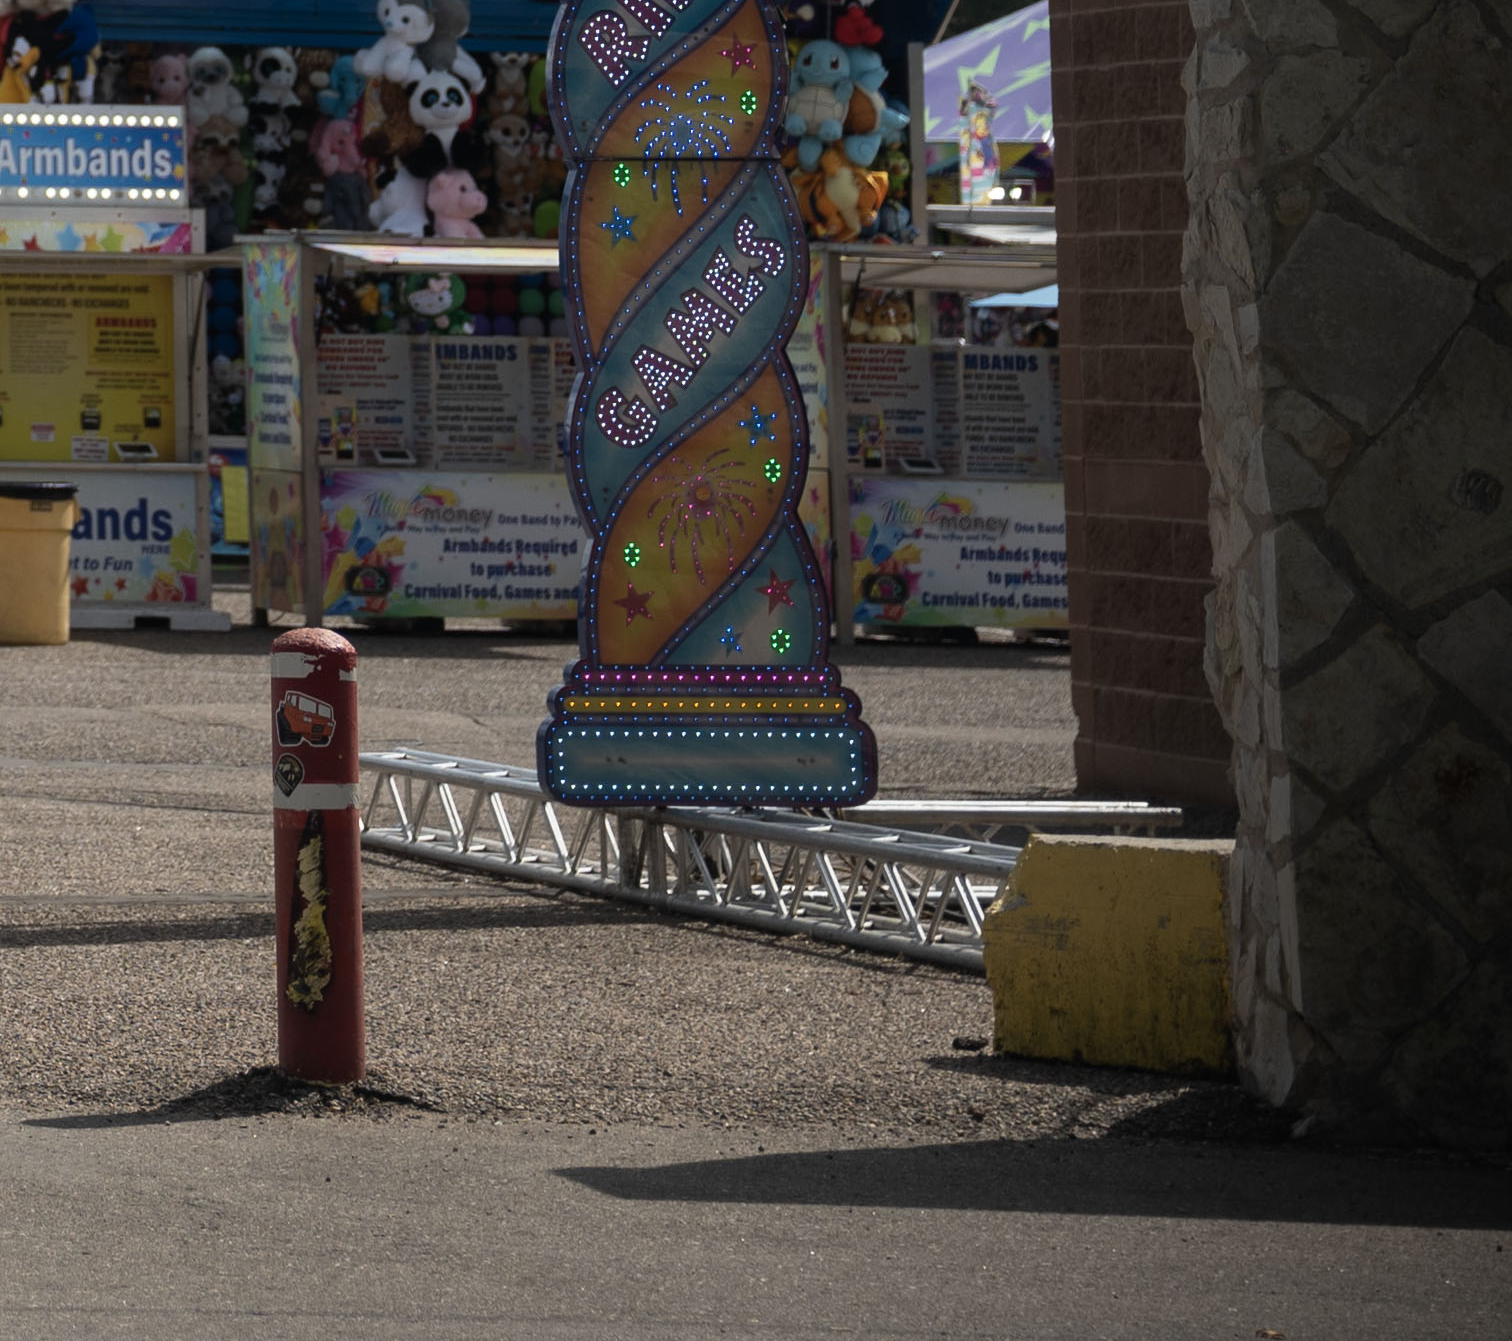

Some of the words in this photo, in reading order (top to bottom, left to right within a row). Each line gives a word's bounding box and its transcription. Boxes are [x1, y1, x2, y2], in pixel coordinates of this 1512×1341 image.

[597, 213, 786, 449] GAMES
[435, 343, 519, 362] MBANDS
[963, 353, 1039, 373] MBANDS
[69, 497, 174, 543] ands
[422, 506, 494, 527] money
[498, 513, 518, 525] One
[520, 513, 548, 525] Band
[939, 515, 1009, 536] money
[1014, 522, 1035, 534] One
[443, 538, 513, 554] Armbands
[515, 538, 578, 557] Required
[960, 546, 1030, 563] Armbands
[1032, 547, 1067, 565] Requ
[83, 556, 100, 571] to
[103, 556, 134, 571] Fun
[470, 561, 485, 576] to
[487, 561, 553, 579] purchase
[987, 570, 1002, 585] to
[404, 583, 462, 600] Carnival
[465, 584, 502, 601] Food,
[505, 585, 551, 600] Games
[553, 584, 580, 600] and
[921, 591, 980, 608] Carnival
[982, 592, 1020, 609] Food,
[1022, 592, 1069, 608] Games
